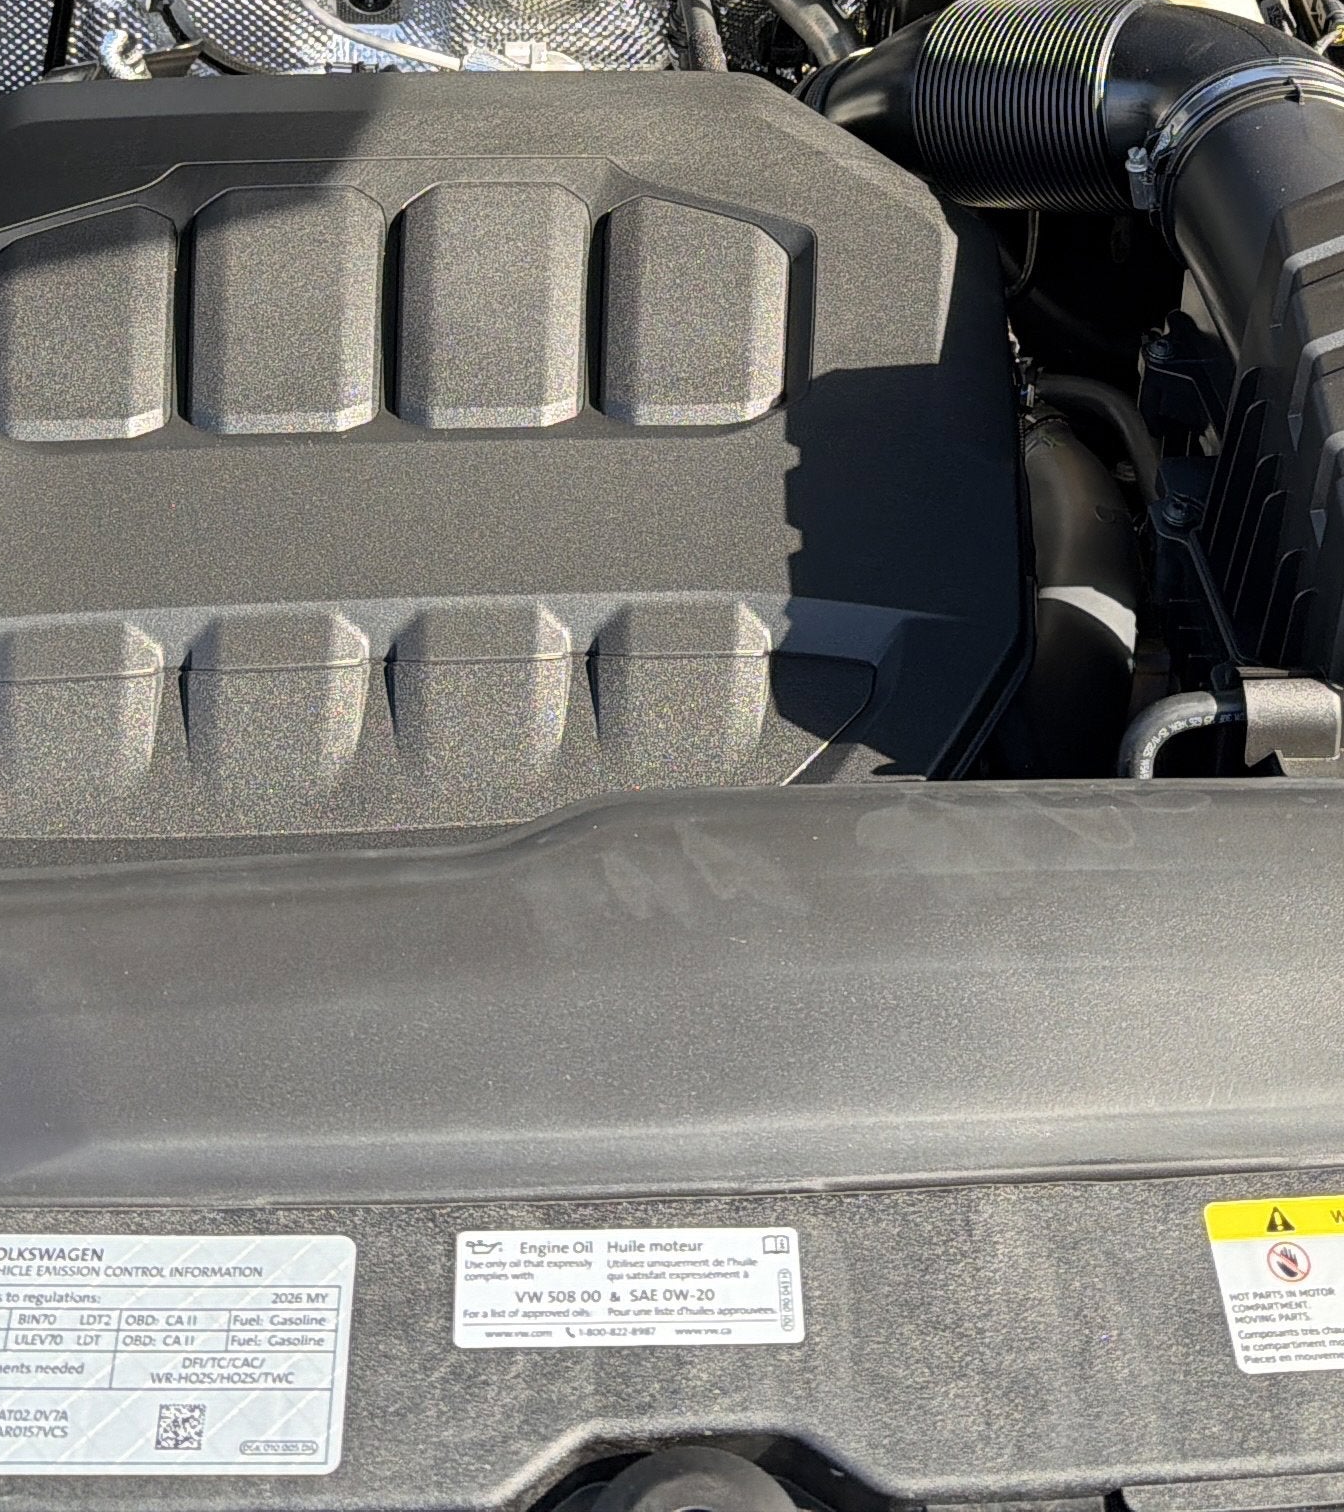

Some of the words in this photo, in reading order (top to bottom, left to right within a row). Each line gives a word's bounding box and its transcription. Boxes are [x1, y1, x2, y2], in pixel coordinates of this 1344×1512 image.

[520, 1241, 570, 1258] Engine
[573, 1241, 594, 1254] Oil
[607, 1240, 646, 1253] Huile
[649, 1241, 703, 1253] moteur
[464, 1260, 484, 1270] Use
[485, 1260, 507, 1271] only
[509, 1259, 522, 1268] oil
[523, 1259, 545, 1268] that
[546, 1259, 593, 1270] expressly
[607, 1259, 645, 1268] Utilisez
[647, 1258, 710, 1269] uniquement
[712, 1258, 725, 1267] de
[36, 1265, 101, 1278] EMISSION
[103, 1266, 166, 1278] CONTROL
[169, 1266, 263, 1278] INFORMATION
[464, 1273, 510, 1283] complies
[511, 1272, 535, 1281] with
[607, 1272, 624, 1283] qui
[626, 1271, 667, 1280] satisfait
[743, 1270, 750, 1279] à
[5, 1292, 20, 1303] to
[23, 1291, 101, 1306] regulations:
[271, 1292, 303, 1304] 2026
[305, 1292, 328, 1304] MY
[515, 1291, 544, 1303] VW
[547, 1290, 576, 1303] 508
[580, 1290, 602, 1303] 00
[609, 1291, 621, 1303] &
[629, 1289, 659, 1302] SAE
[663, 1288, 715, 1302] 0W-20
[1228, 1290, 1250, 1302] HOT
[1252, 1289, 1283, 1300] PARTS
[1286, 1289, 1296, 1298] IN
[1299, 1288, 1336, 1298] MOTOR
[463, 1309, 480, 1319] For
[482, 1310, 489, 1319] a
[490, 1308, 506, 1318] list
[508, 1308, 520, 1318] of
[521, 1308, 570, 1319] approved
[607, 1307, 631, 1317] Pour
[633, 1308, 653, 1317] une
[654, 1307, 674, 1316] liste
[17, 1313, 57, 1326] BIN70
[79, 1313, 112, 1326] LDT2
[125, 1315, 159, 1327] OBD:
[165, 1315, 186, 1327] CA
[233, 1315, 263, 1326] Fuel:
[269, 1314, 327, 1326] Gasoline
[1234, 1314, 1276, 1324] MOVING
[14, 1334, 64, 1346] ULEV70
[76, 1334, 102, 1346] LDT
[122, 1335, 157, 1347] OBD:
[162, 1335, 184, 1347] CA
[230, 1335, 262, 1347] Fuel:
[267, 1335, 325, 1347] Gasoline
[485, 1330, 553, 1338] www.vw.com
[1238, 1328, 1300, 1341] Composants
[1240, 1342, 1251, 1351] le
[1253, 1339, 1326, 1353] compartiment
[181, 1357, 266, 1370] DFI/TC/CAC/
[1279, 1354, 1292, 1362] en
[34, 1362, 85, 1375] needed
[150, 1372, 295, 1385] WR-HO2S/HO2S/TWC
